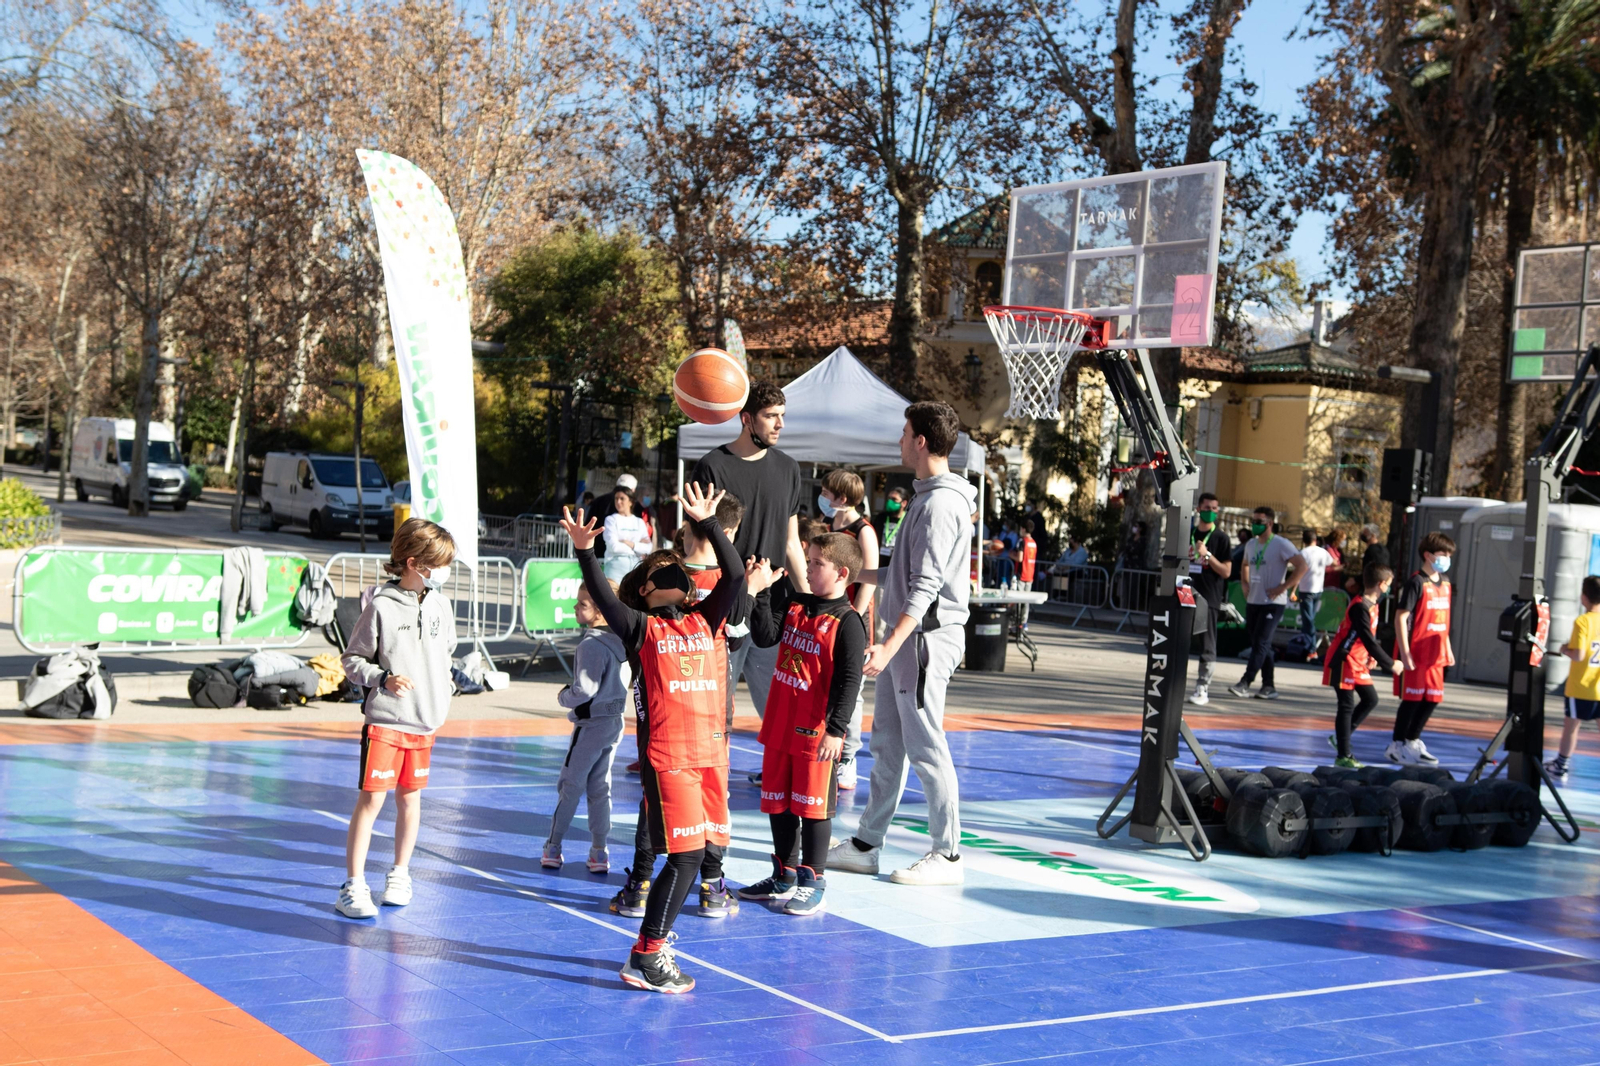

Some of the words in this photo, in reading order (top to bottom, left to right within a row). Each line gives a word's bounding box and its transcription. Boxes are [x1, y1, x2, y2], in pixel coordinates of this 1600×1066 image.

[1079, 207, 1138, 226] TARMAK
[1179, 287, 1203, 336] 2
[781, 631, 821, 656] RANADA
[679, 654, 706, 677] 57
[780, 649, 803, 673] 23
[669, 679, 718, 693] PULEVA
[1143, 610, 1170, 746] TARMAK
[760, 790, 785, 800] ULEVA
[673, 823, 705, 838] PULEV
